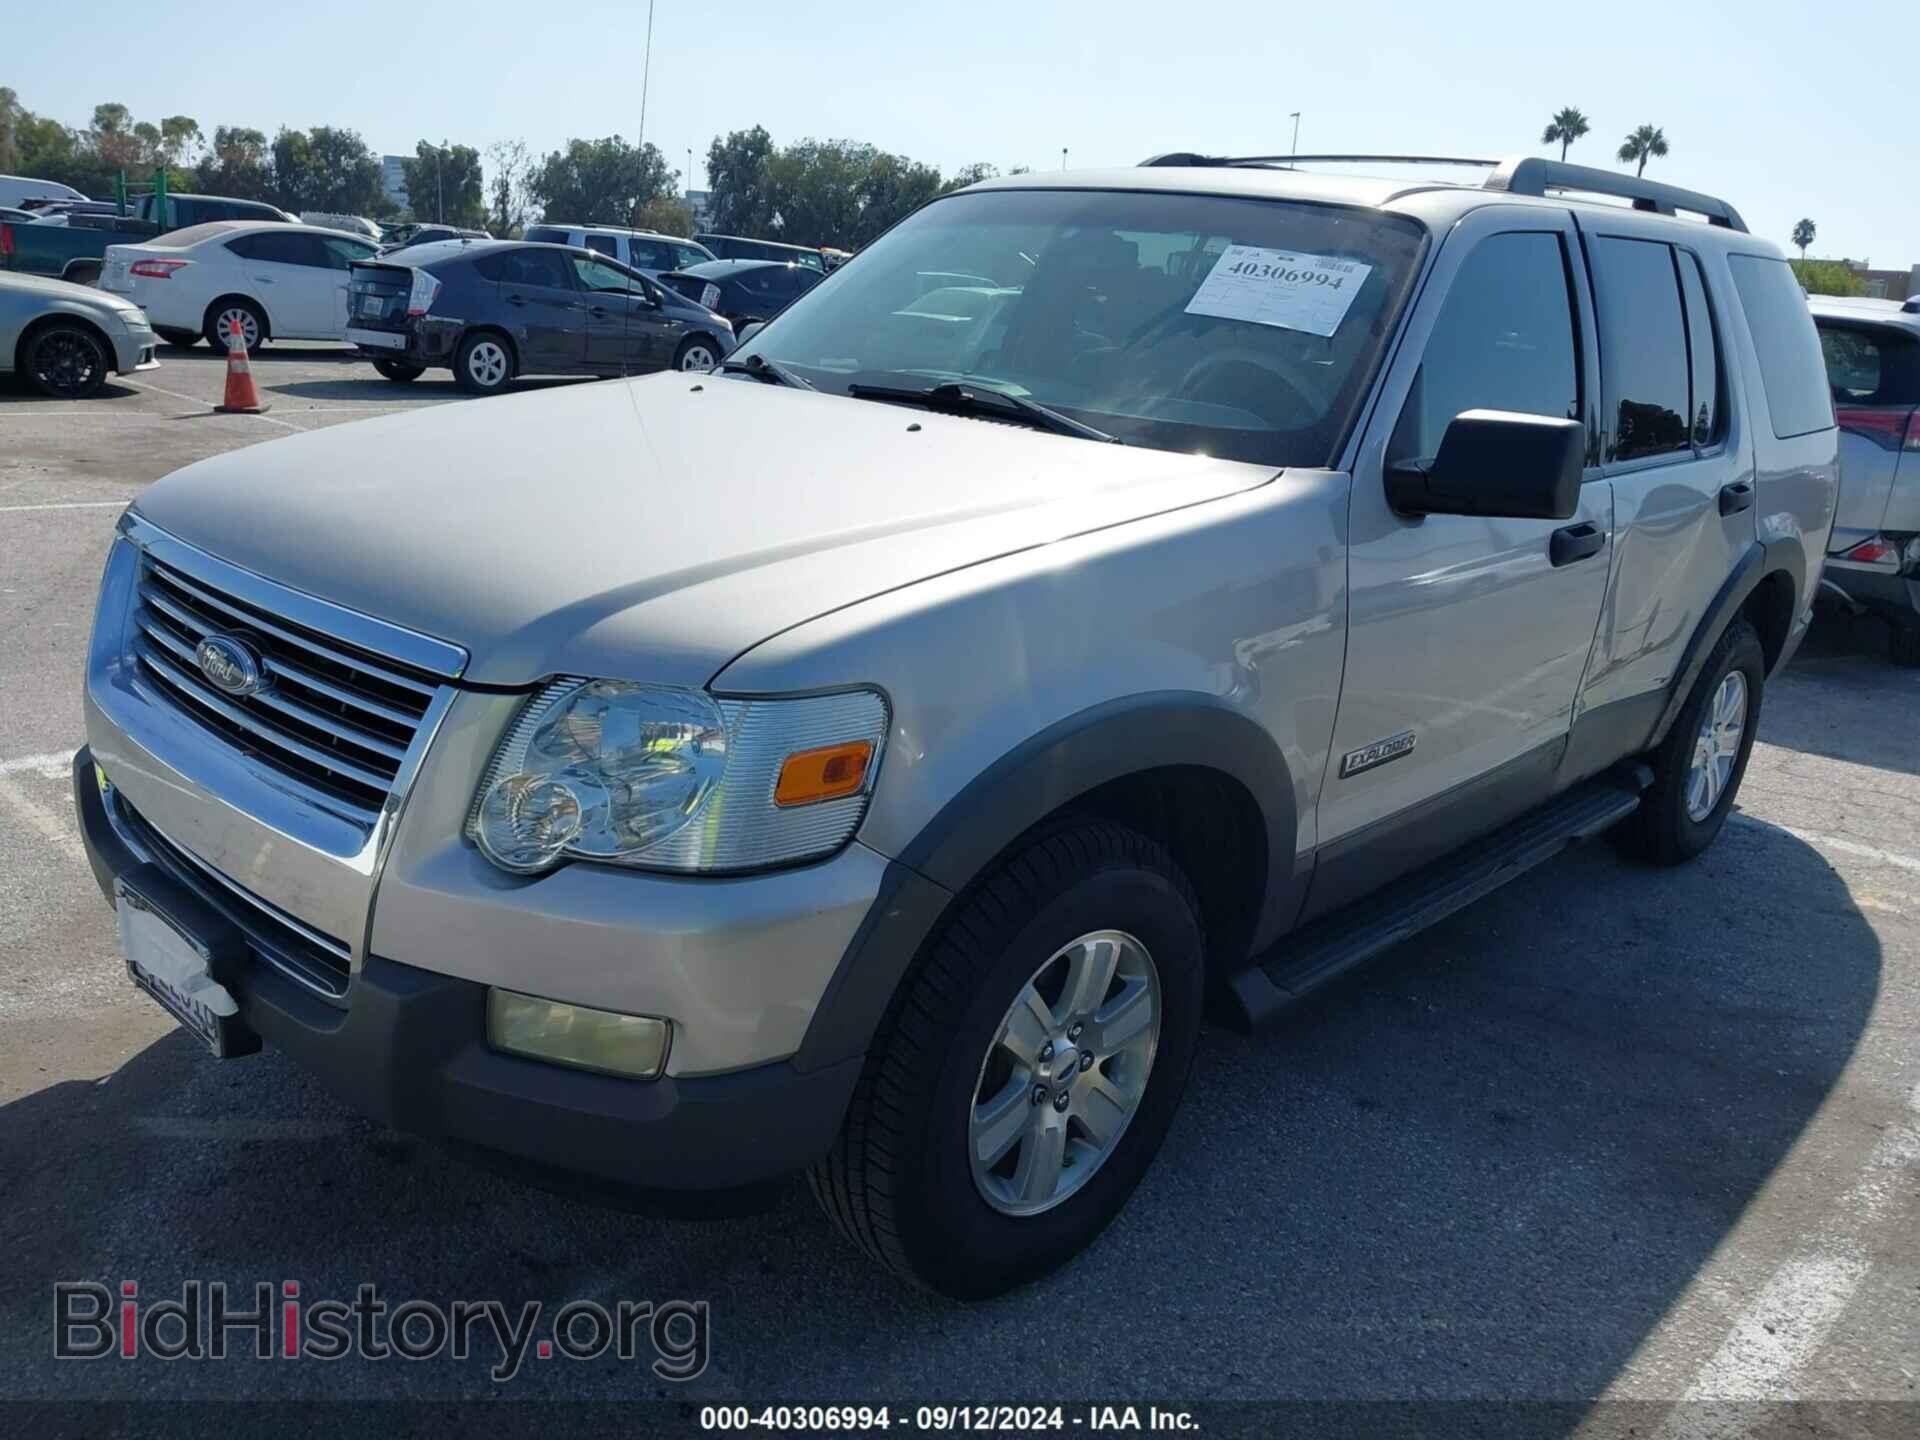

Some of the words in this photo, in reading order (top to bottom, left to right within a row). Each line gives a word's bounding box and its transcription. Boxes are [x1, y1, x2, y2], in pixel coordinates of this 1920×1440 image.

[1228, 260, 1344, 290] 40306994
[202, 644, 235, 681] Ford
[1347, 733, 1417, 769] EXPLORER
